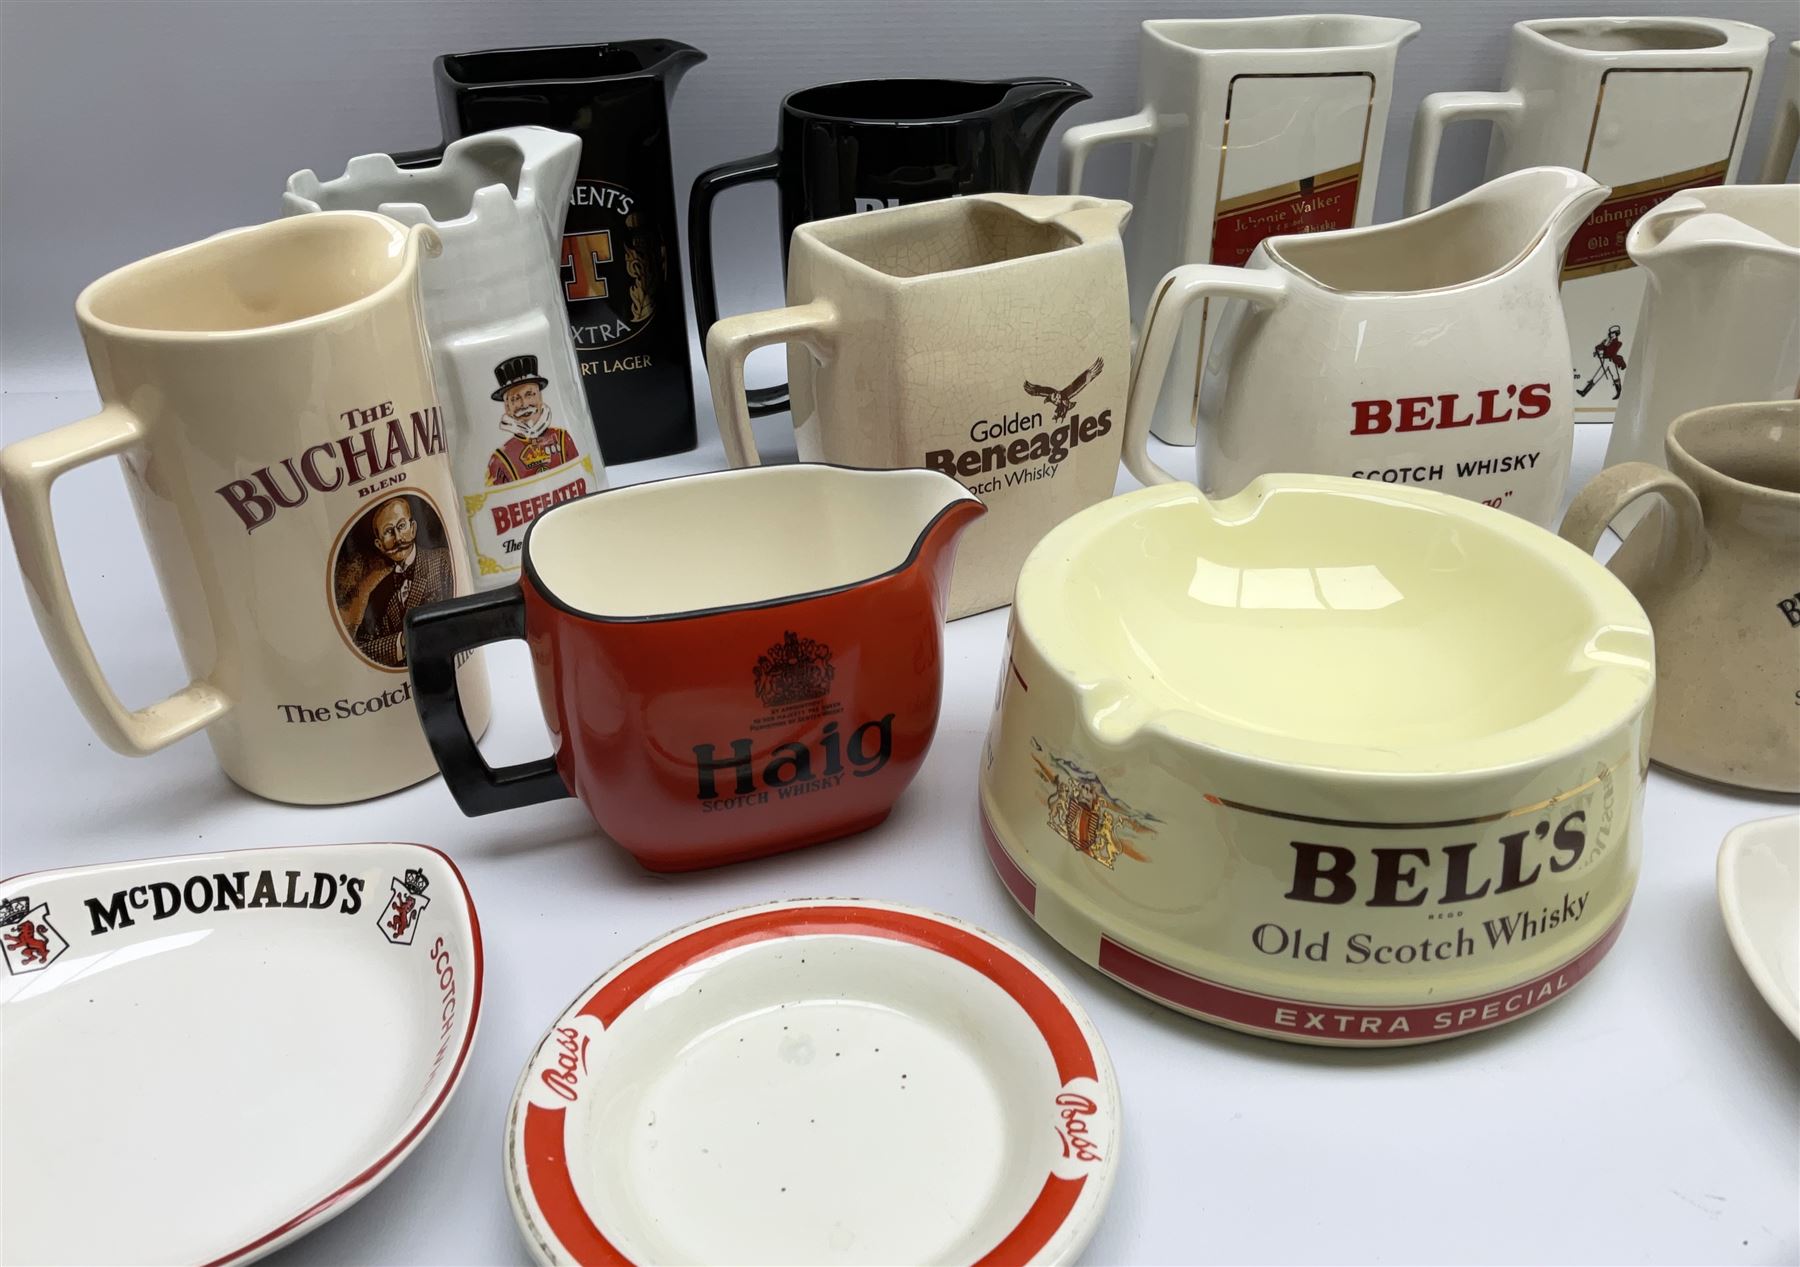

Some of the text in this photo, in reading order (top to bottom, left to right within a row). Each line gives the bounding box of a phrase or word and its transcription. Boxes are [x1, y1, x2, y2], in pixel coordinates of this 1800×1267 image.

[570, 186, 634, 215] ENT'S
[1290, 195, 1341, 215] Walker
[1588, 204, 1648, 226] Johnnie
[571, 319, 631, 344] XTRA
[603, 355, 652, 374] LAGER
[340, 401, 394, 430] THE
[1350, 383, 1551, 435] BELL'S
[925, 409, 1112, 479] Beneagles
[970, 412, 1042, 443] Golden
[358, 472, 407, 499] BLEND
[967, 463, 1059, 496] otch Whisky
[1352, 452, 1541, 483] SCOTCH WHISKY
[491, 477, 587, 536] BEEFEATER
[502, 539, 523, 554] The
[277, 704, 331, 723] The
[692, 713, 896, 800] Haig
[702, 773, 845, 813] SCOTCH WHISKY
[1283, 810, 1587, 908] BELL'S
[84, 870, 365, 936] McDONALD'S
[1252, 891, 1592, 965] Old Scotch Whisky
[430, 936, 456, 1040] SCOTCH
[1275, 975, 1569, 1034] EXTRA SPECIAL
[541, 1027, 580, 1101] Bass
[1055, 1093, 1102, 1163] Bass
